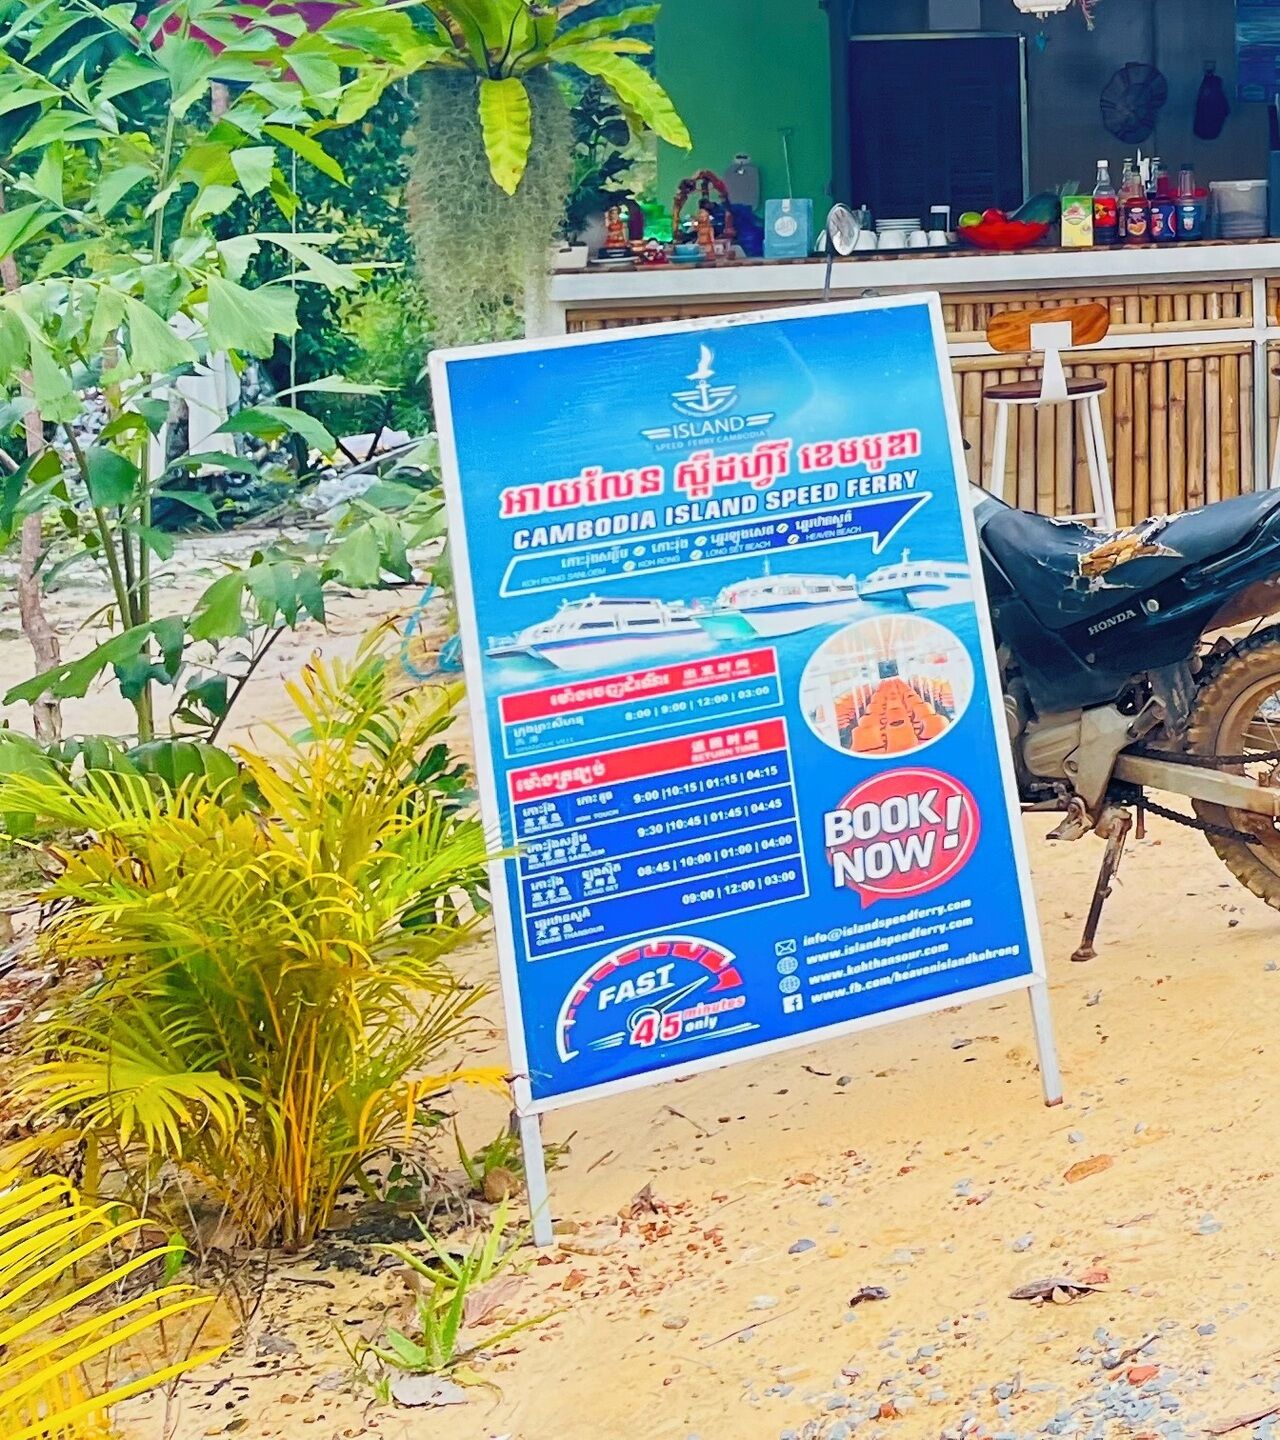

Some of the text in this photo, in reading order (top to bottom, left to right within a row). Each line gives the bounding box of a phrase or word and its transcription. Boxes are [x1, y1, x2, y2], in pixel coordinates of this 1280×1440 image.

[655, 431, 766, 451] SPEED FERRY CAMBODIA
[673, 416, 745, 439] ISLAND
[514, 469, 919, 550] CAMBODIA ISLAND SPEED FERRY
[1088, 609, 1137, 636] HONDA
[697, 693, 729, 709] 12:00
[738, 685, 770, 700] 03:00
[633, 789, 660, 805] 9:00
[706, 772, 739, 789] 01:15
[746, 765, 779, 781] 04:15
[637, 823, 663, 839] 9:30
[710, 806, 743, 823] 01:45
[750, 798, 783, 815] 04:45
[824, 788, 943, 848] BOOK
[680, 851, 712, 868] 10:00
[720, 843, 753, 860] 01:00
[761, 834, 793, 851] 04:00
[832, 830, 937, 888] NOW
[681, 870, 797, 906] 09:00 12:00 03:00
[803, 897, 972, 948] info@islandspeedferry.com
[806, 916, 974, 967] www.islandspeedferry.com
[808, 941, 949, 986] www.kohthansour.com
[810, 944, 1020, 1005] www.fb.com/heavenislandkohrong
[597, 962, 676, 1011] FAST
[630, 994, 747, 1048] 45 minutes
[684, 1014, 718, 1034] only
